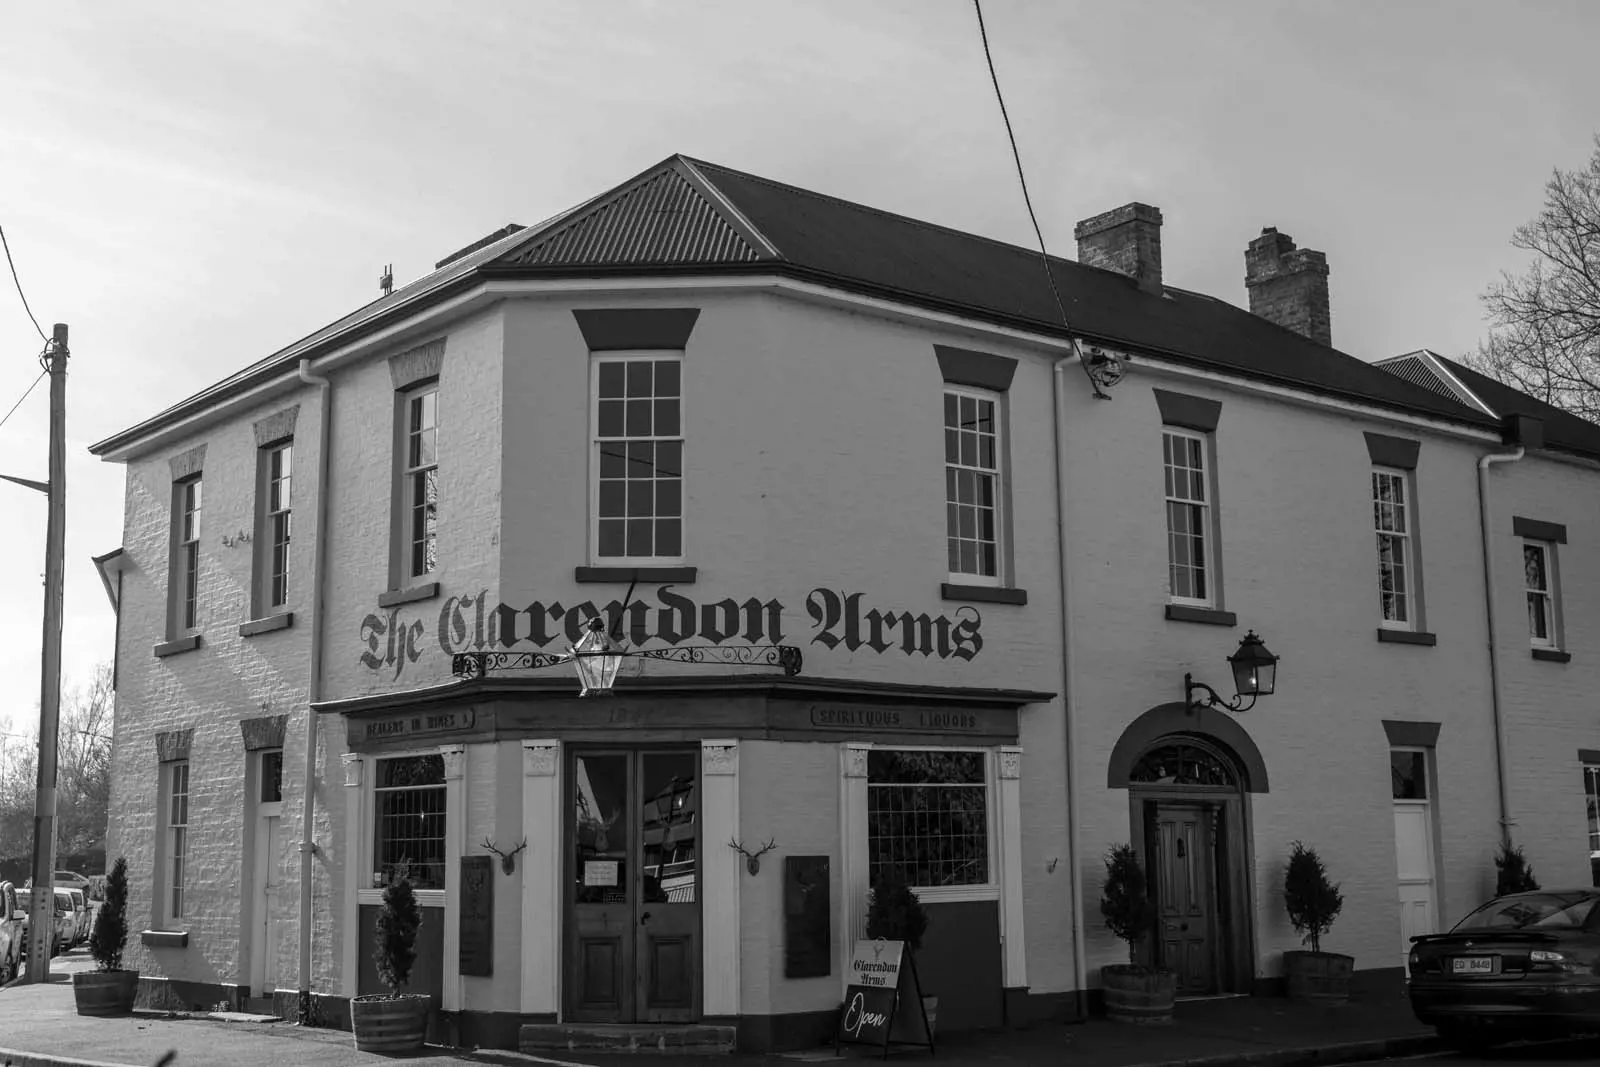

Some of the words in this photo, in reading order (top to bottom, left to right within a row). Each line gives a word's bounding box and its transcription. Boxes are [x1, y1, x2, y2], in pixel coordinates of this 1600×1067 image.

[360, 607, 425, 682] The
[438, 584, 785, 656] Clarendon
[806, 587, 983, 662] Arms
[819, 709, 900, 727] SPIRITUOUS
[920, 711, 978, 728] LIQUORS
[853, 959, 898, 973] Clarendon
[844, 991, 886, 1038] Open
